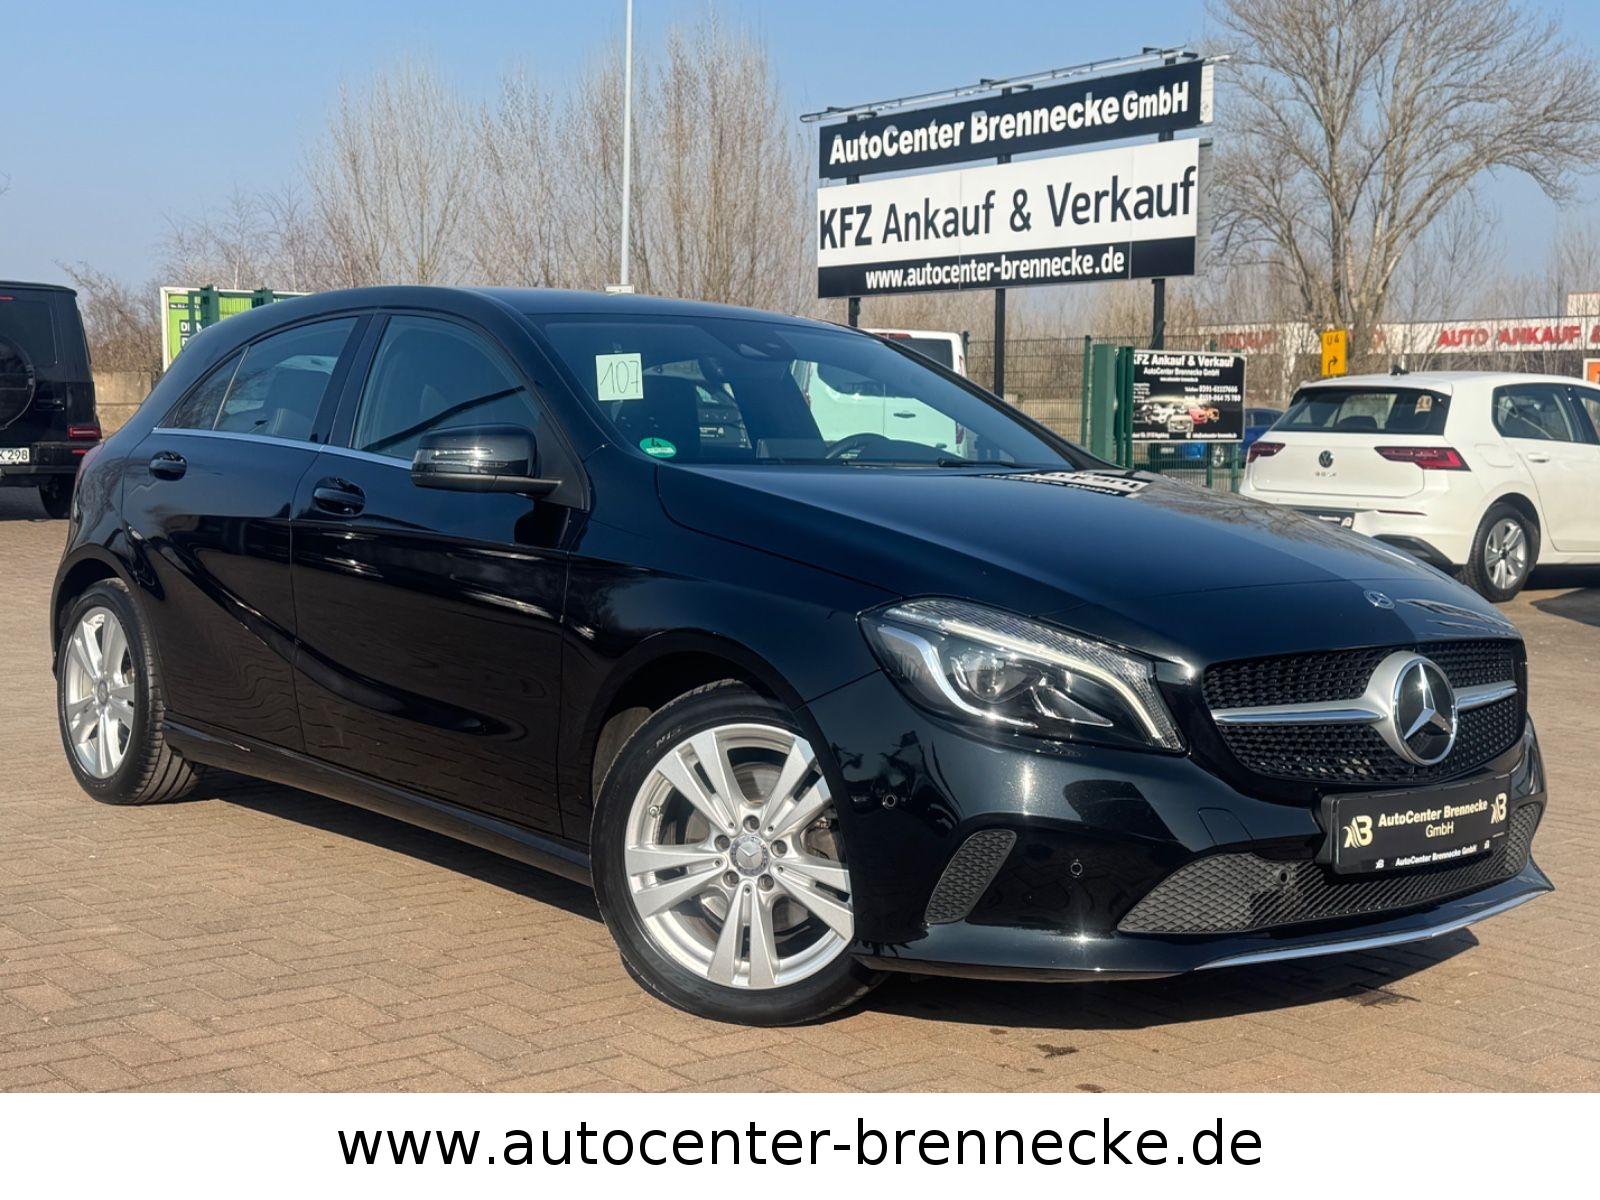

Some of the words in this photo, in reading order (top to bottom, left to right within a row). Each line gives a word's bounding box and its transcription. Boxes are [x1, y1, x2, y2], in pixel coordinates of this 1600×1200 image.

[829, 121, 965, 165] AutoCenter
[970, 91, 1119, 144] Brennecke
[1123, 80, 1190, 120] GmbH
[819, 203, 873, 250] KFZ
[882, 189, 996, 244] Ankauf
[1009, 187, 1032, 232] &
[1047, 165, 1197, 227] Verkauf
[865, 245, 1125, 289] www.autocenter-brennecke.de
[1438, 328, 1490, 347] AUTO
[1498, 325, 1581, 345] ANKAUF
[1151, 355, 1185, 366] Ankauf
[1187, 356, 1196, 366] &
[1198, 356, 1234, 368] Verkauf
[600, 360, 640, 394] 107
[8, 449, 28, 460] 298
[1378, 808, 1441, 828] AutoCenter
[1443, 799, 1488, 819] Brennecke
[1425, 821, 1454, 838] GmbH
[1395, 854, 1431, 867] AutoCenter
